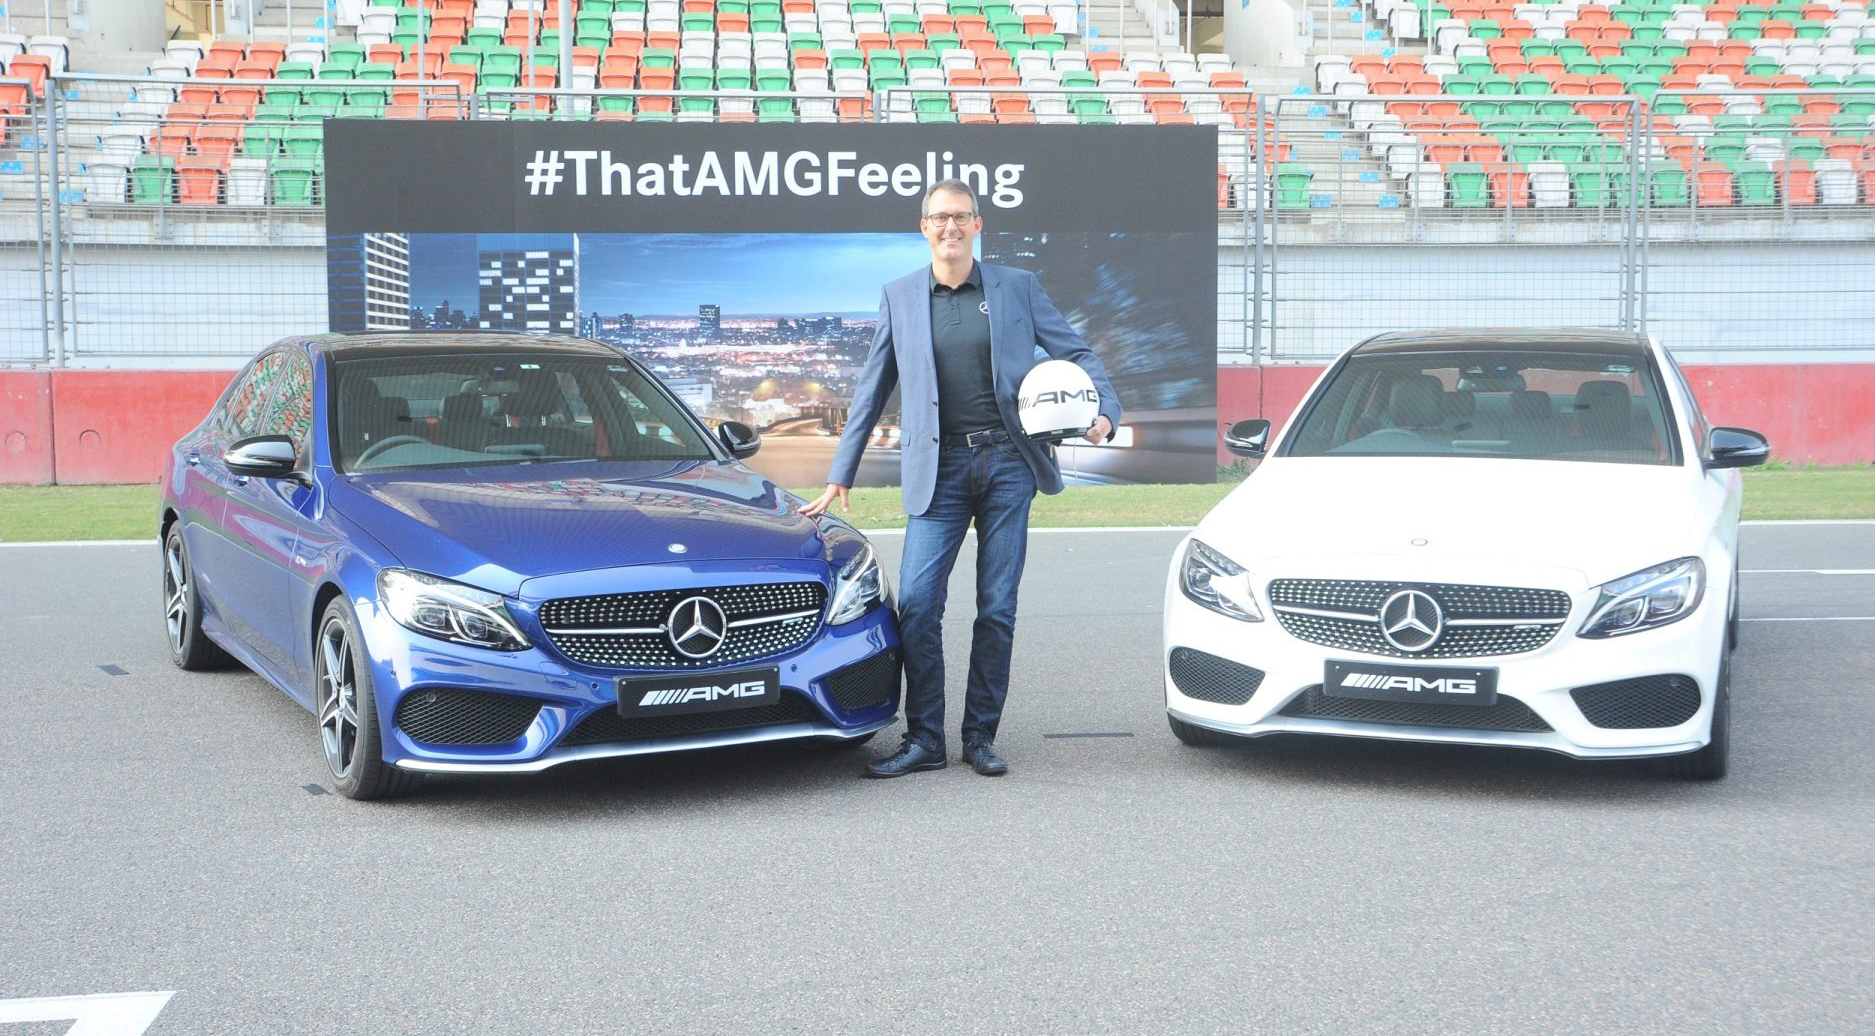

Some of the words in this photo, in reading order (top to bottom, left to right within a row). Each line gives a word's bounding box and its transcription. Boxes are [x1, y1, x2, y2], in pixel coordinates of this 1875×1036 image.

[524, 150, 1025, 209] #ThatAMGFeeling
[1032, 389, 1098, 408] AMG
[681, 681, 765, 704] AMG
[1382, 676, 1477, 694] AMG
